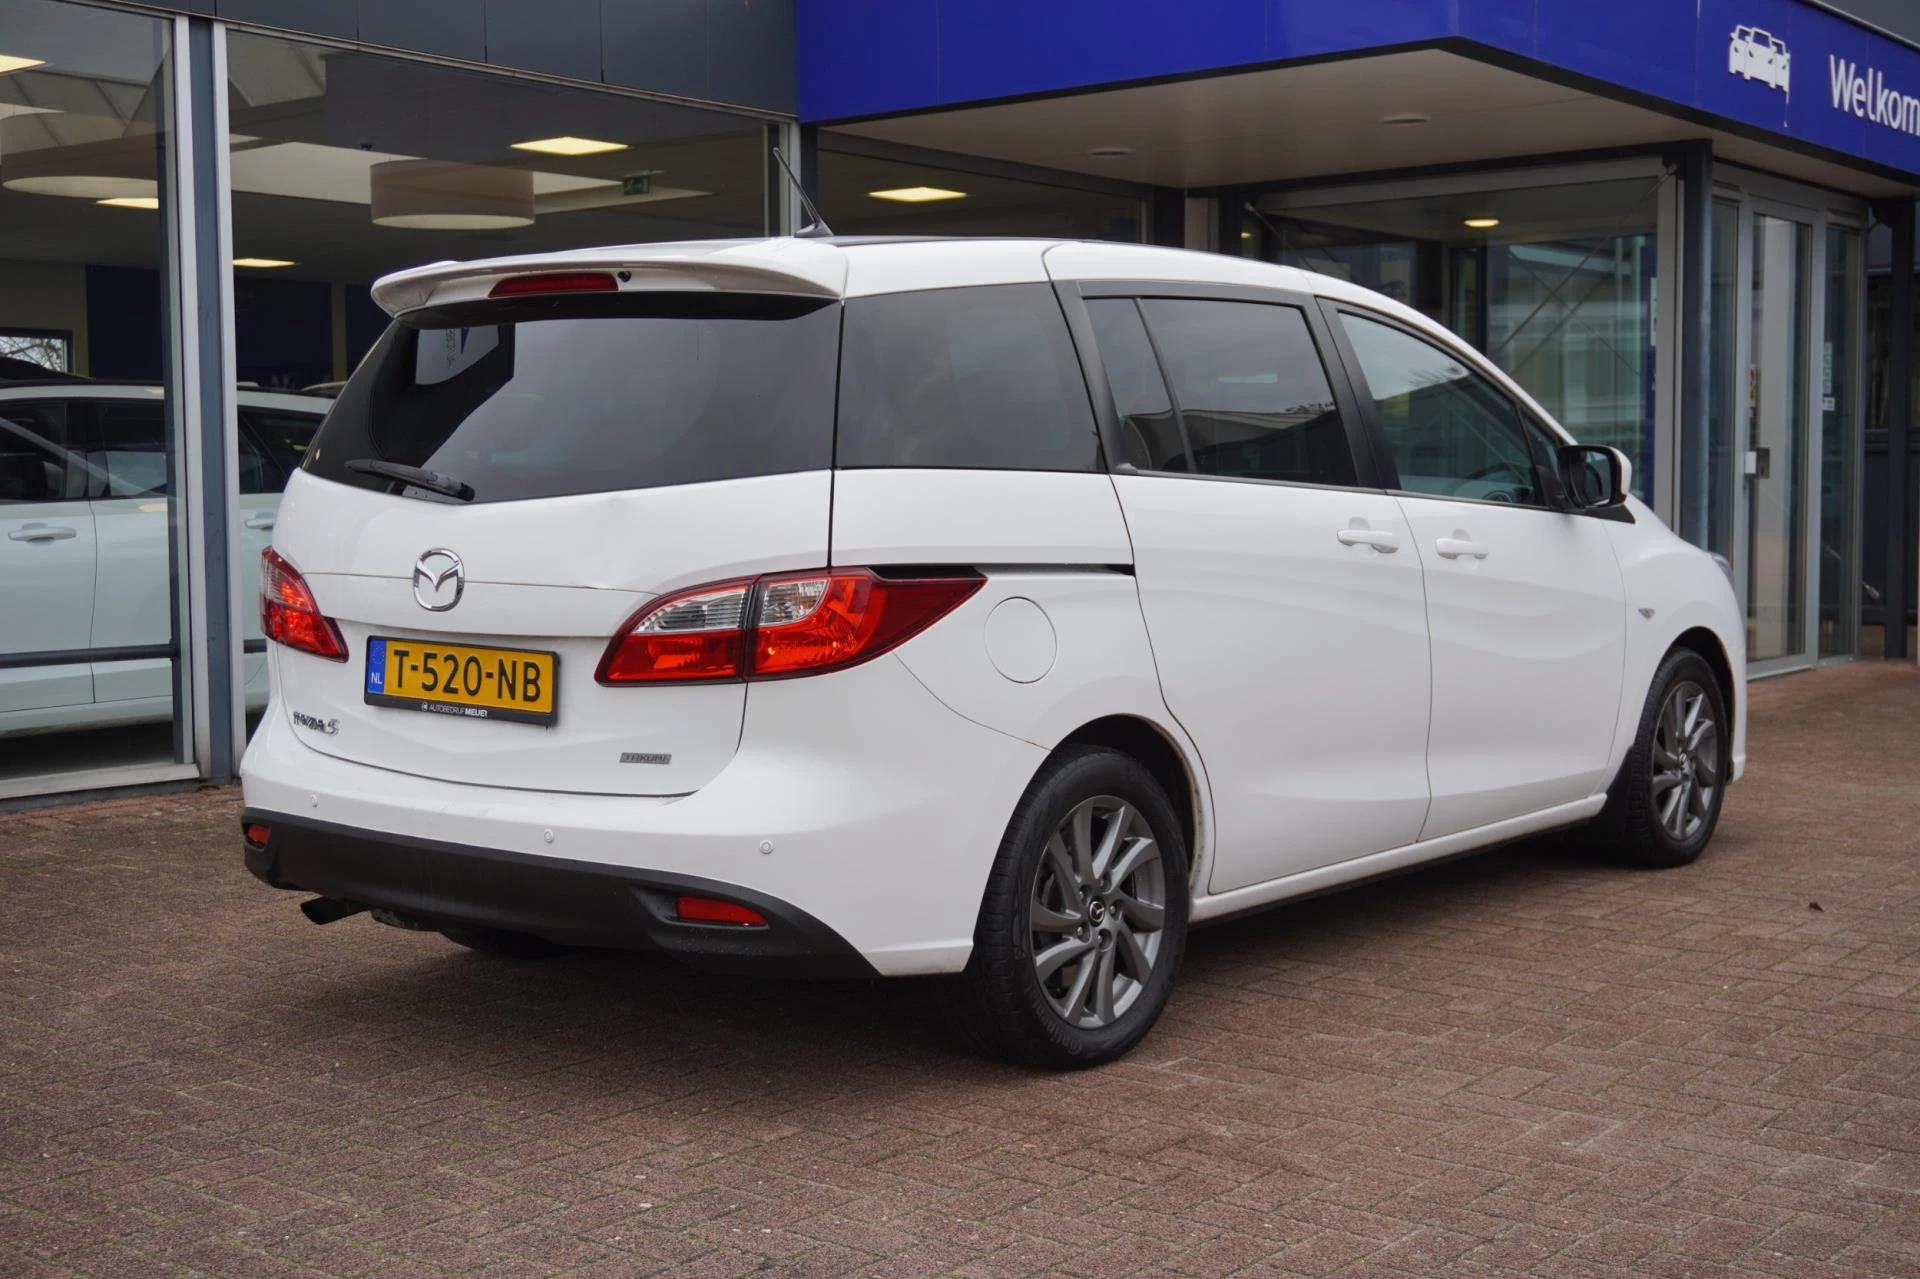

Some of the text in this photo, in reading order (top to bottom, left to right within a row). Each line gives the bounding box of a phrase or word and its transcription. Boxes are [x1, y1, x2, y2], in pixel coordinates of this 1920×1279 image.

[1829, 54, 1920, 136] Welkom
[371, 671, 383, 685] NL
[394, 648, 541, 702] T-520-NB
